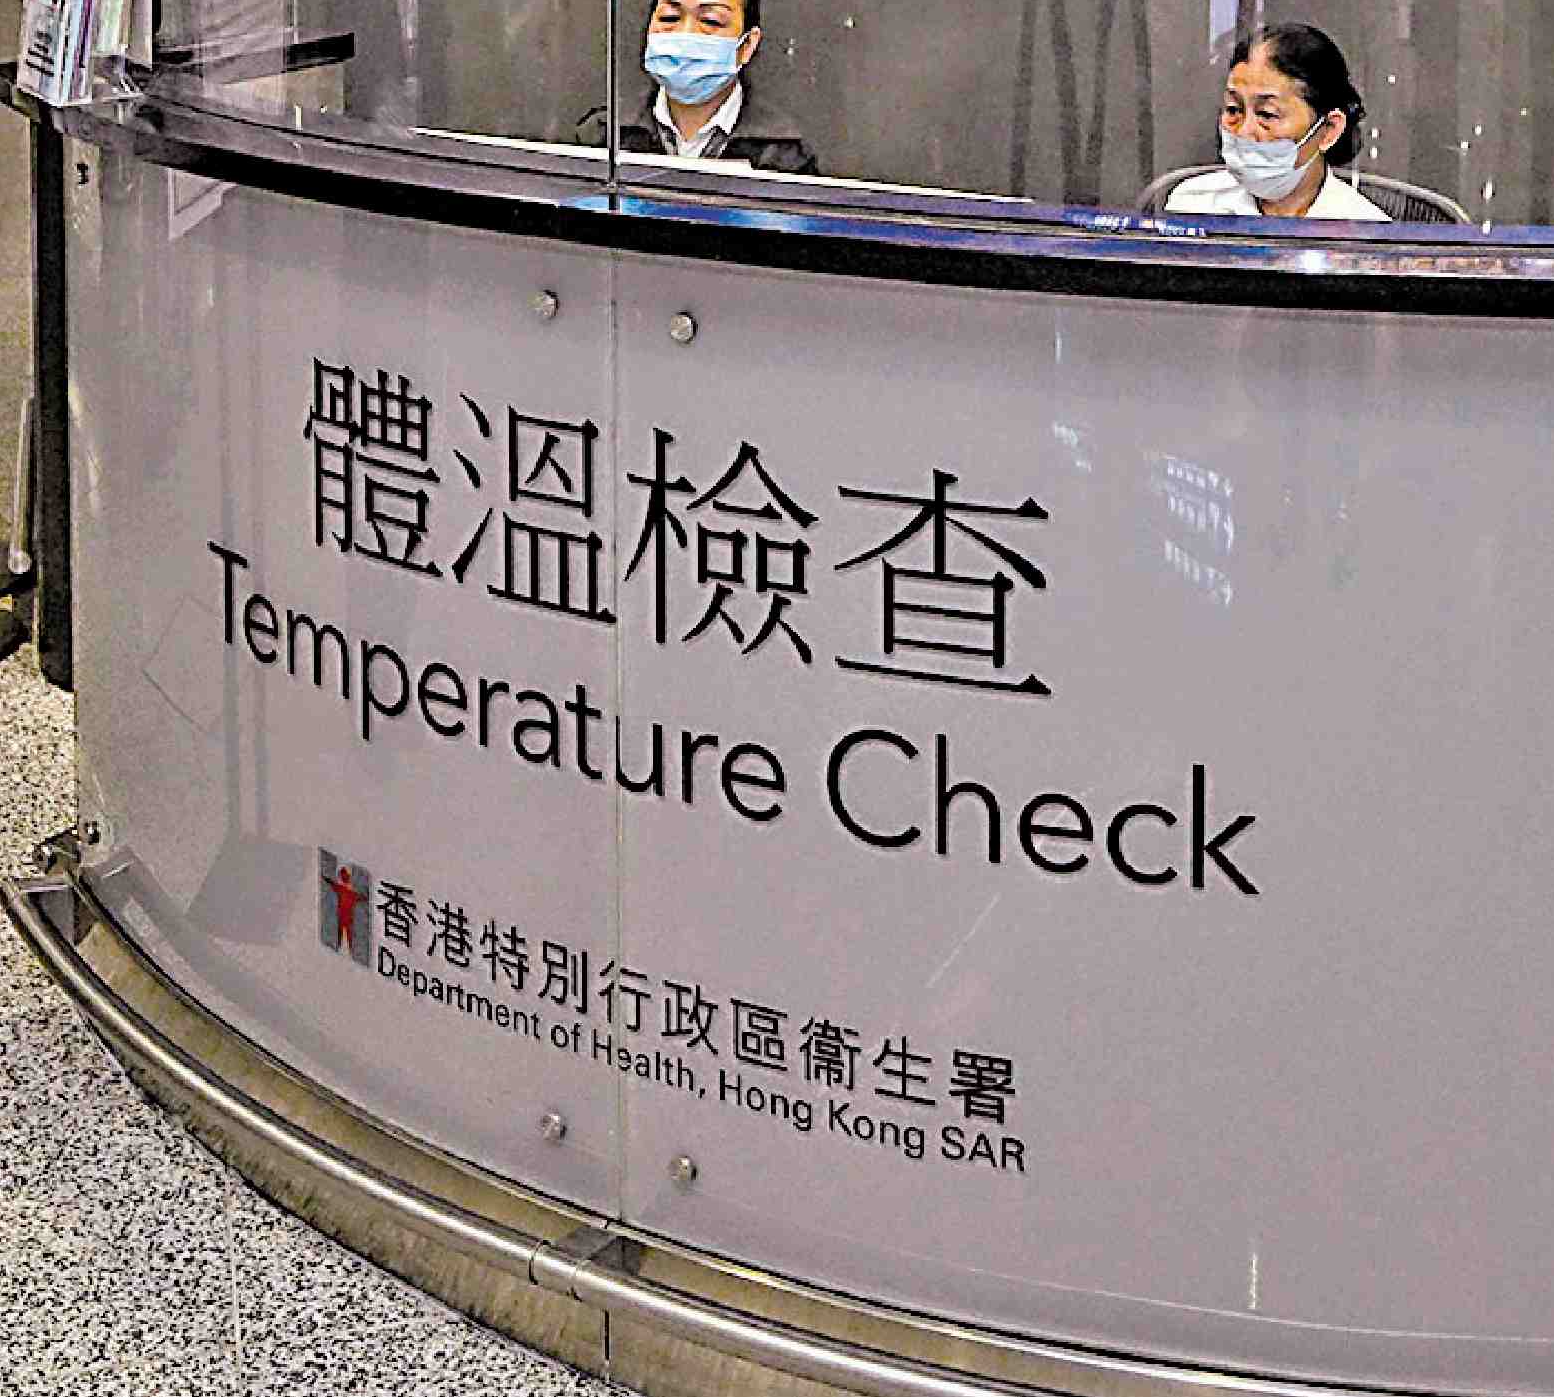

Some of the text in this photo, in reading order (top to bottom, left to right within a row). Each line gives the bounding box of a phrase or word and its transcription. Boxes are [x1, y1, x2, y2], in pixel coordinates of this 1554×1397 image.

[303, 356, 1051, 699] 體溫檢查
[207, 540, 1261, 897] Temperature Check
[377, 946, 1026, 1174] Department of Health, Hong Kong SAR
